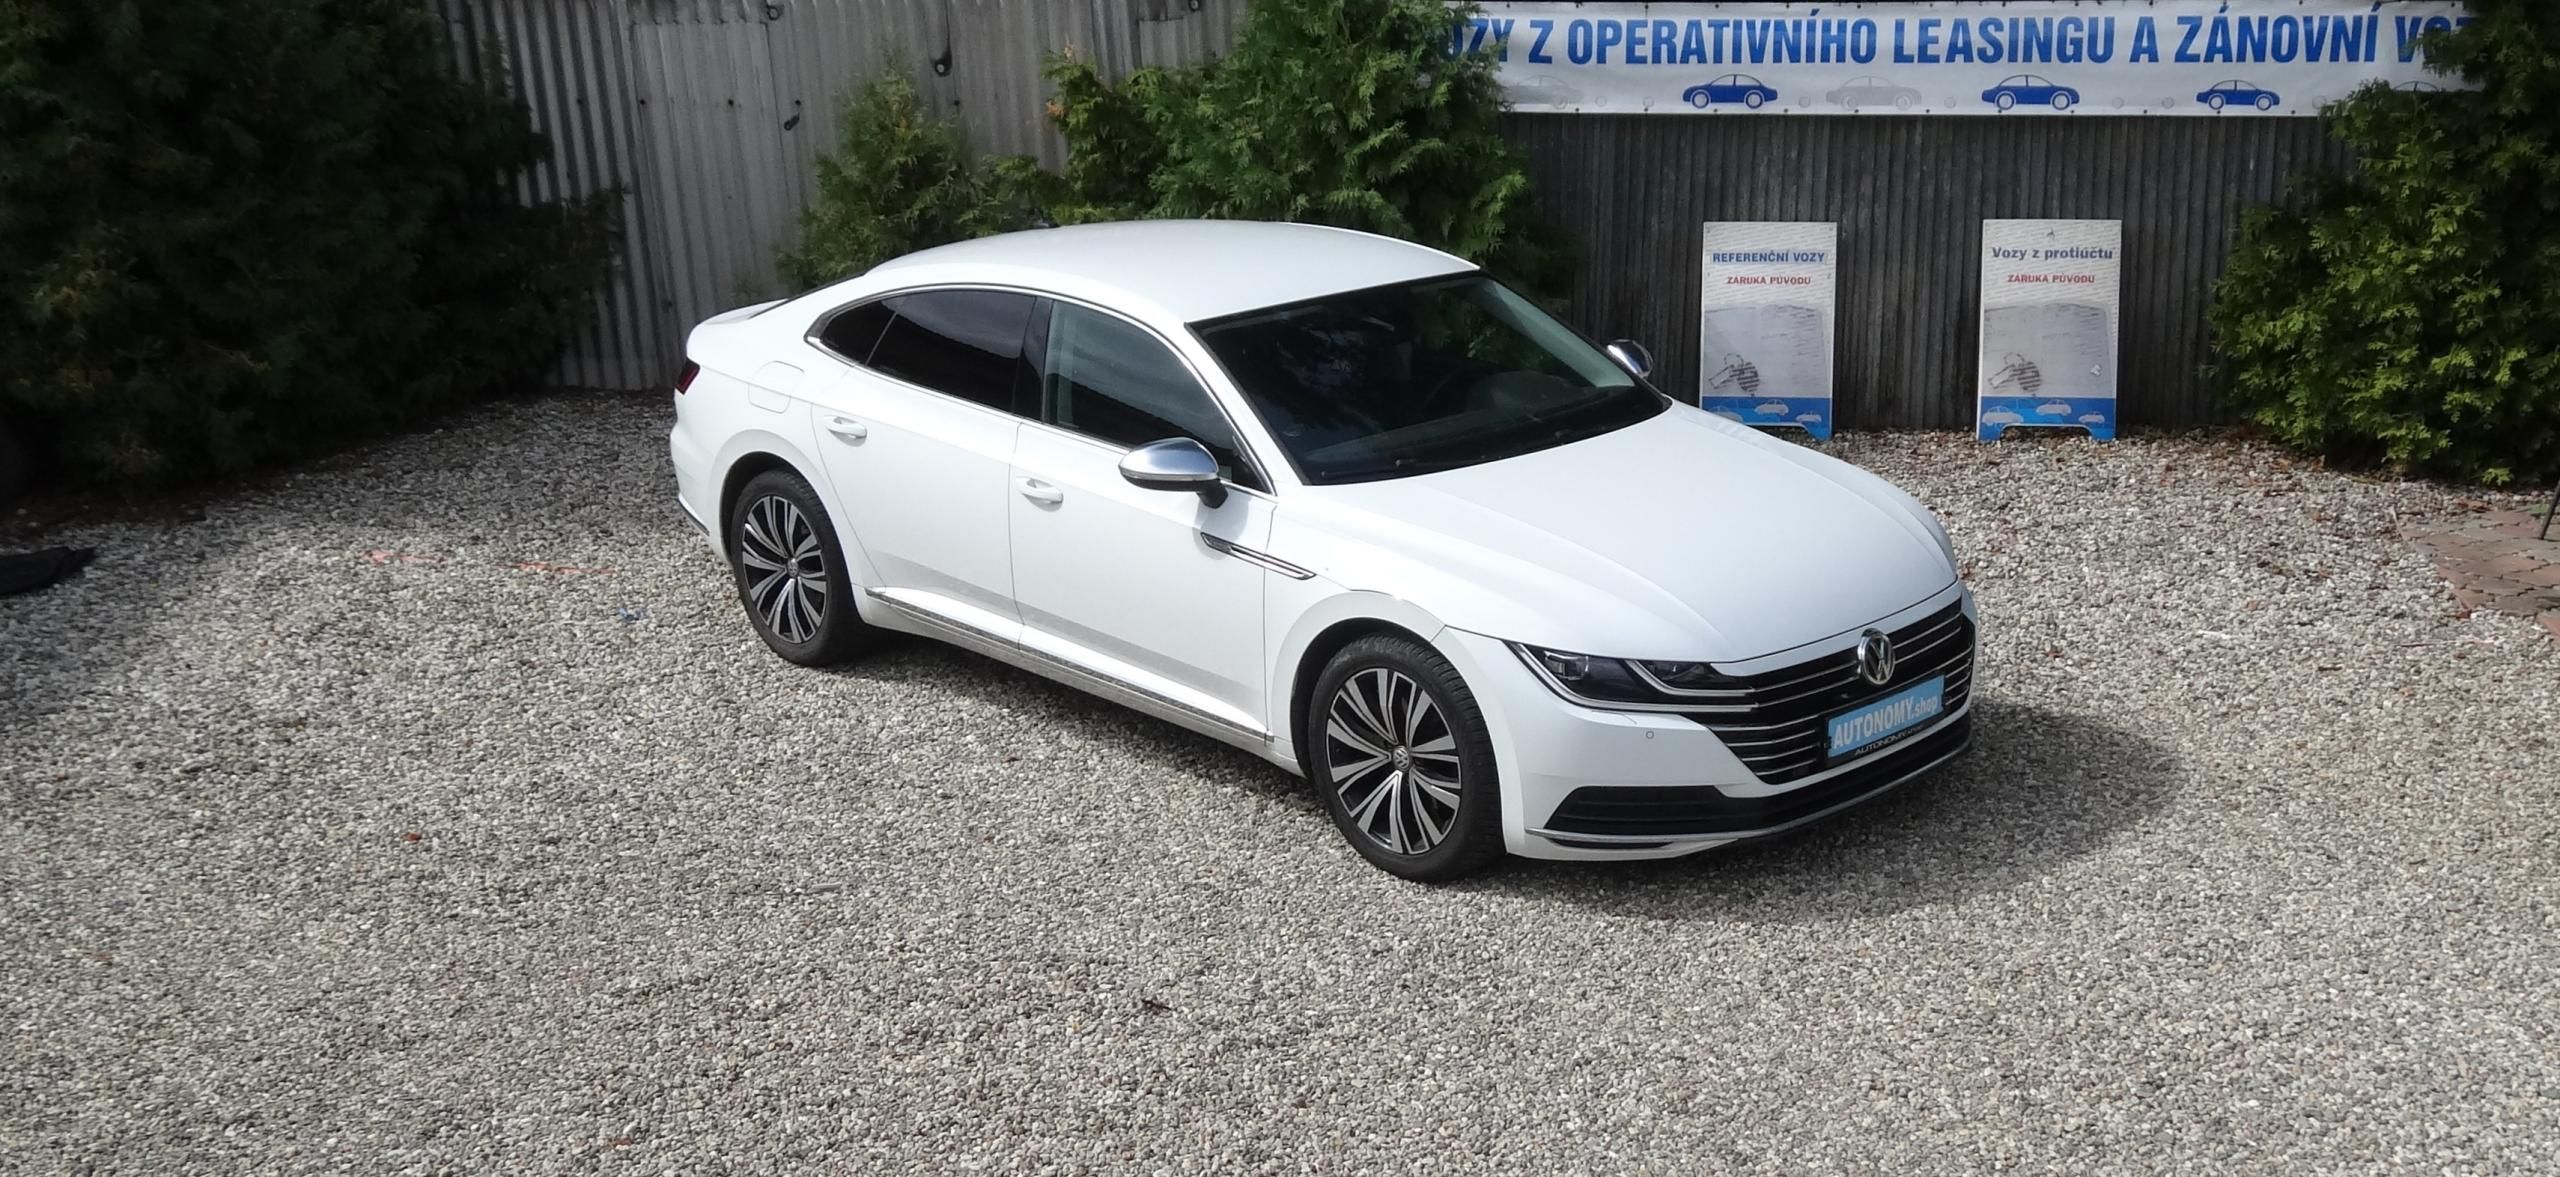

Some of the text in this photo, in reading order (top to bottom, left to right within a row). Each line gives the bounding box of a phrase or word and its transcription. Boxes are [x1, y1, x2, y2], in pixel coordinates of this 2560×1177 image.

[1528, 19, 1554, 64] Z
[1567, 9, 1878, 65] OPERATIVNÍHO
[1893, 16, 2115, 64] LEASINGU
[2128, 16, 2159, 63] A
[2174, 3, 2381, 63] ZÁNOVNÍ
[1712, 250, 1825, 263] REFERENČNÍ VOZY
[1992, 247, 2027, 260] Vozy
[2032, 249, 2040, 258] z
